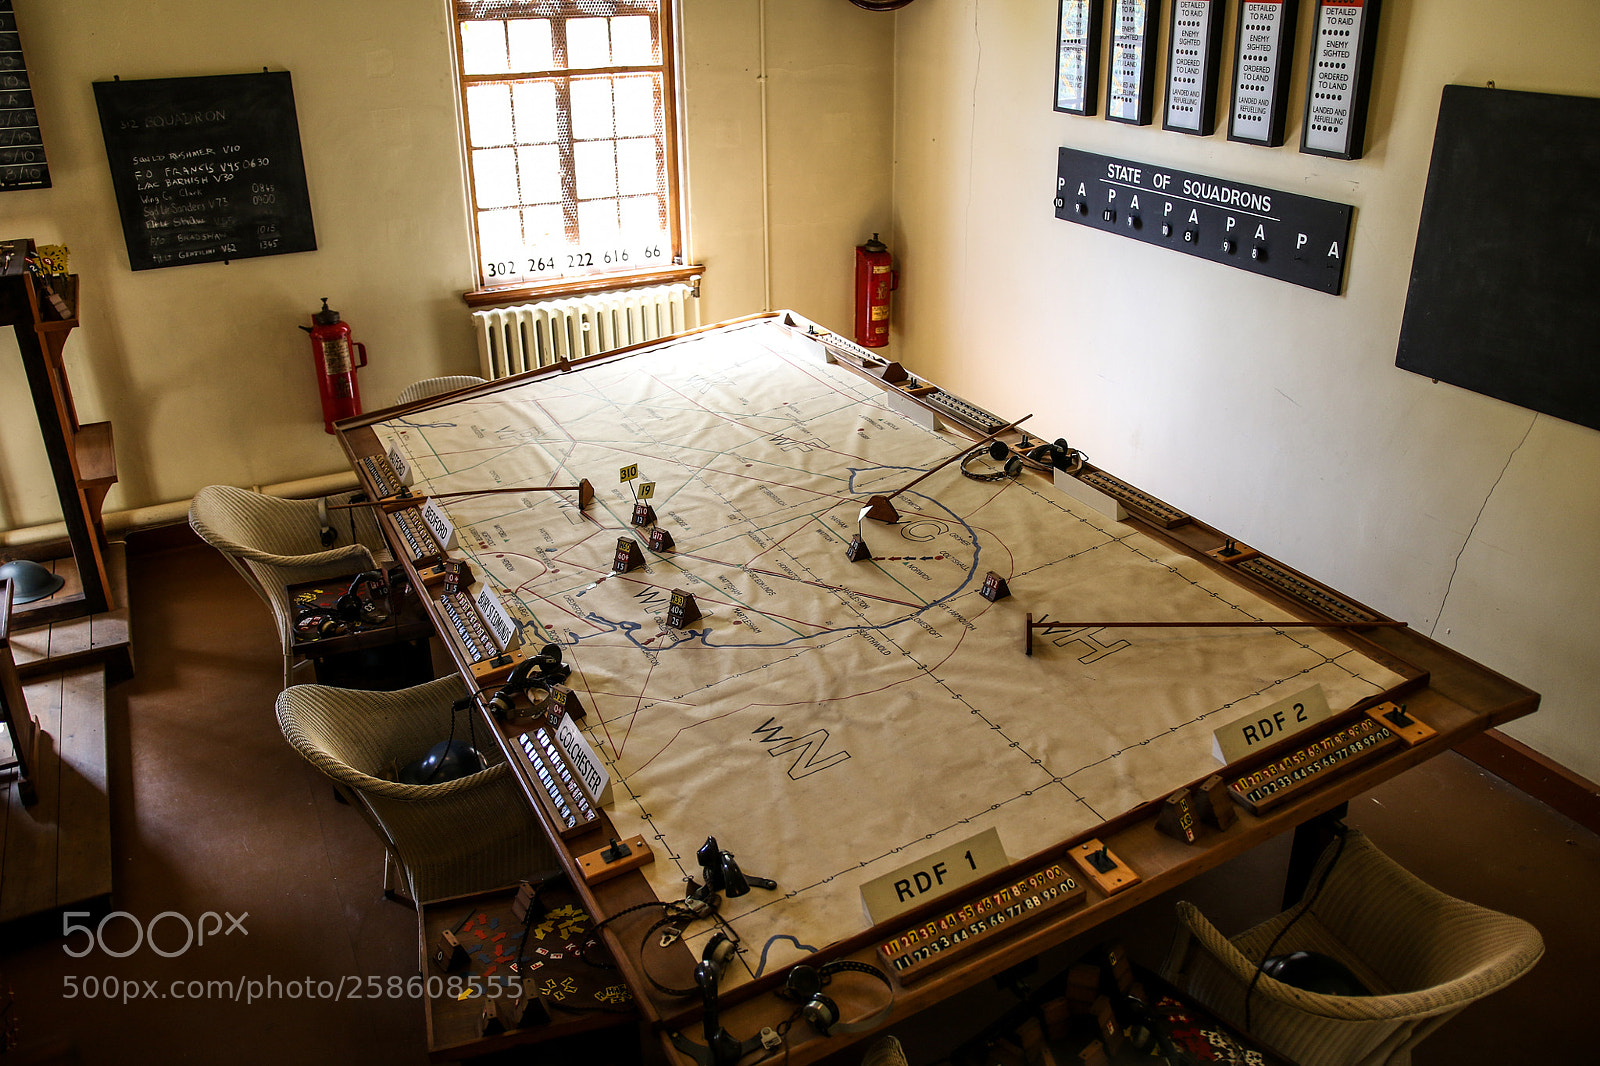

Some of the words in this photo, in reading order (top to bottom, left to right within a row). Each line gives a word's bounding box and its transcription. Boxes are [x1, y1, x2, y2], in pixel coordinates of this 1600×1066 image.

[1248, 4, 1277, 12] DETAILED
[1326, 8, 1356, 16] DETAILED
[1338, 18, 1354, 26] RAID
[1182, 30, 1199, 38] ENEMY
[1250, 34, 1270, 42] ENEMY
[1179, 38, 1200, 46] SIGHTED
[1326, 40, 1348, 48] ENEMY
[1246, 43, 1272, 52] SIGHTED
[1323, 50, 1350, 58] SIGHTED
[1176, 58, 1200, 67] ORDERED
[1243, 64, 1270, 74] ORDERED
[1252, 74, 1270, 82] LAND
[1318, 72, 1348, 82] ORDERED
[1328, 82, 1348, 90] LAND
[1172, 88, 1190, 97] LANDED
[1173, 97, 1198, 105] REFUELLING
[1238, 96, 1258, 105] LANDED
[1258, 98, 1270, 106] AND
[1240, 105, 1266, 114] REFUELLING
[1312, 106, 1334, 115] LANDED
[1334, 107, 1346, 116] AND
[1314, 115, 1344, 125] REFUELLING
[165, 162, 215, 177] FRANCIS
[1108, 163, 1142, 184] STATE
[1153, 173, 1171, 190] OF
[1183, 180, 1272, 212] SQUADRONS
[1058, 177, 1066, 190] P
[1078, 182, 1086, 196] A
[1108, 188, 1116, 202] P
[1130, 194, 1140, 210] A
[1164, 202, 1172, 216] P
[1188, 208, 1199, 224] A
[1226, 216, 1236, 232] P
[1254, 224, 1265, 240] A
[1296, 232, 1308, 250] P
[1327, 242, 1340, 258] A
[1055, 198, 1062, 208] 10
[1184, 232, 1192, 242] 8
[1223, 242, 1229, 252] 9
[1252, 248, 1257, 258] 8
[487, 260, 517, 278] 302
[528, 256, 556, 272] 264
[568, 252, 594, 268] 222
[604, 248, 630, 264] 616
[644, 244, 661, 258] 66
[620, 466, 637, 480] 310
[641, 485, 651, 496] 19
[424, 505, 448, 540] BEDFORD
[636, 516, 644, 524] 12
[949, 532, 972, 546] CROMER
[618, 552, 630, 562] 60+
[616, 561, 625, 571] 15
[672, 594, 684, 606] H33
[670, 606, 684, 616] 40+
[672, 616, 680, 626] 25
[732, 607, 762, 634] MARTLESHAM
[550, 714, 558, 726] 30
[1242, 711, 1286, 746] RDF
[1292, 702, 1308, 723] 2
[559, 725, 602, 796] COLCHESTER
[894, 861, 948, 902] RDF
[964, 850, 977, 870] 1
